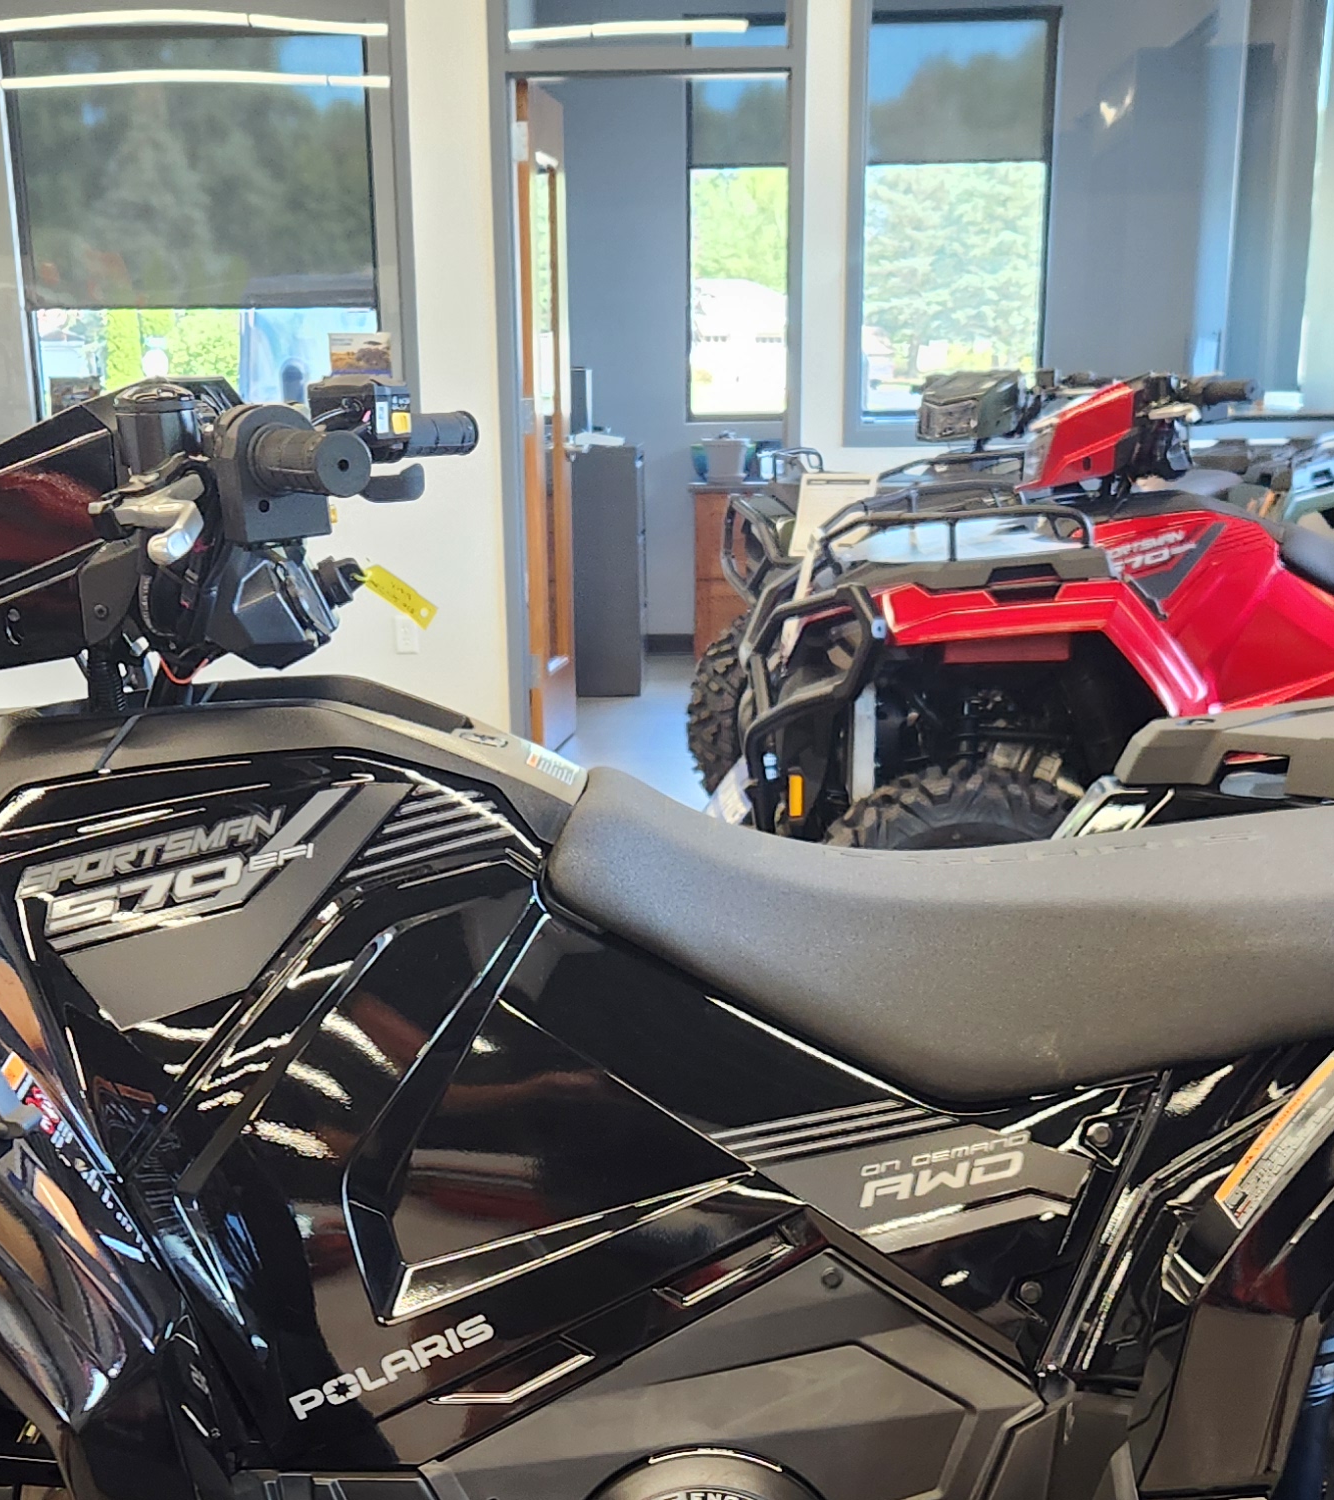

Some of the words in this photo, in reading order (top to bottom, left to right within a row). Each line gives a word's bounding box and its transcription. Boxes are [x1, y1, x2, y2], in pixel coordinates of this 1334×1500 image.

[17, 805, 287, 900] SPORTSMAN
[45, 854, 250, 936] 570
[248, 842, 315, 873] EFI
[859, 1150, 1025, 1208] AWD
[860, 1160, 901, 1177] ON
[911, 1130, 1031, 1167] DEMAND
[288, 1314, 494, 1421] POLARIS
